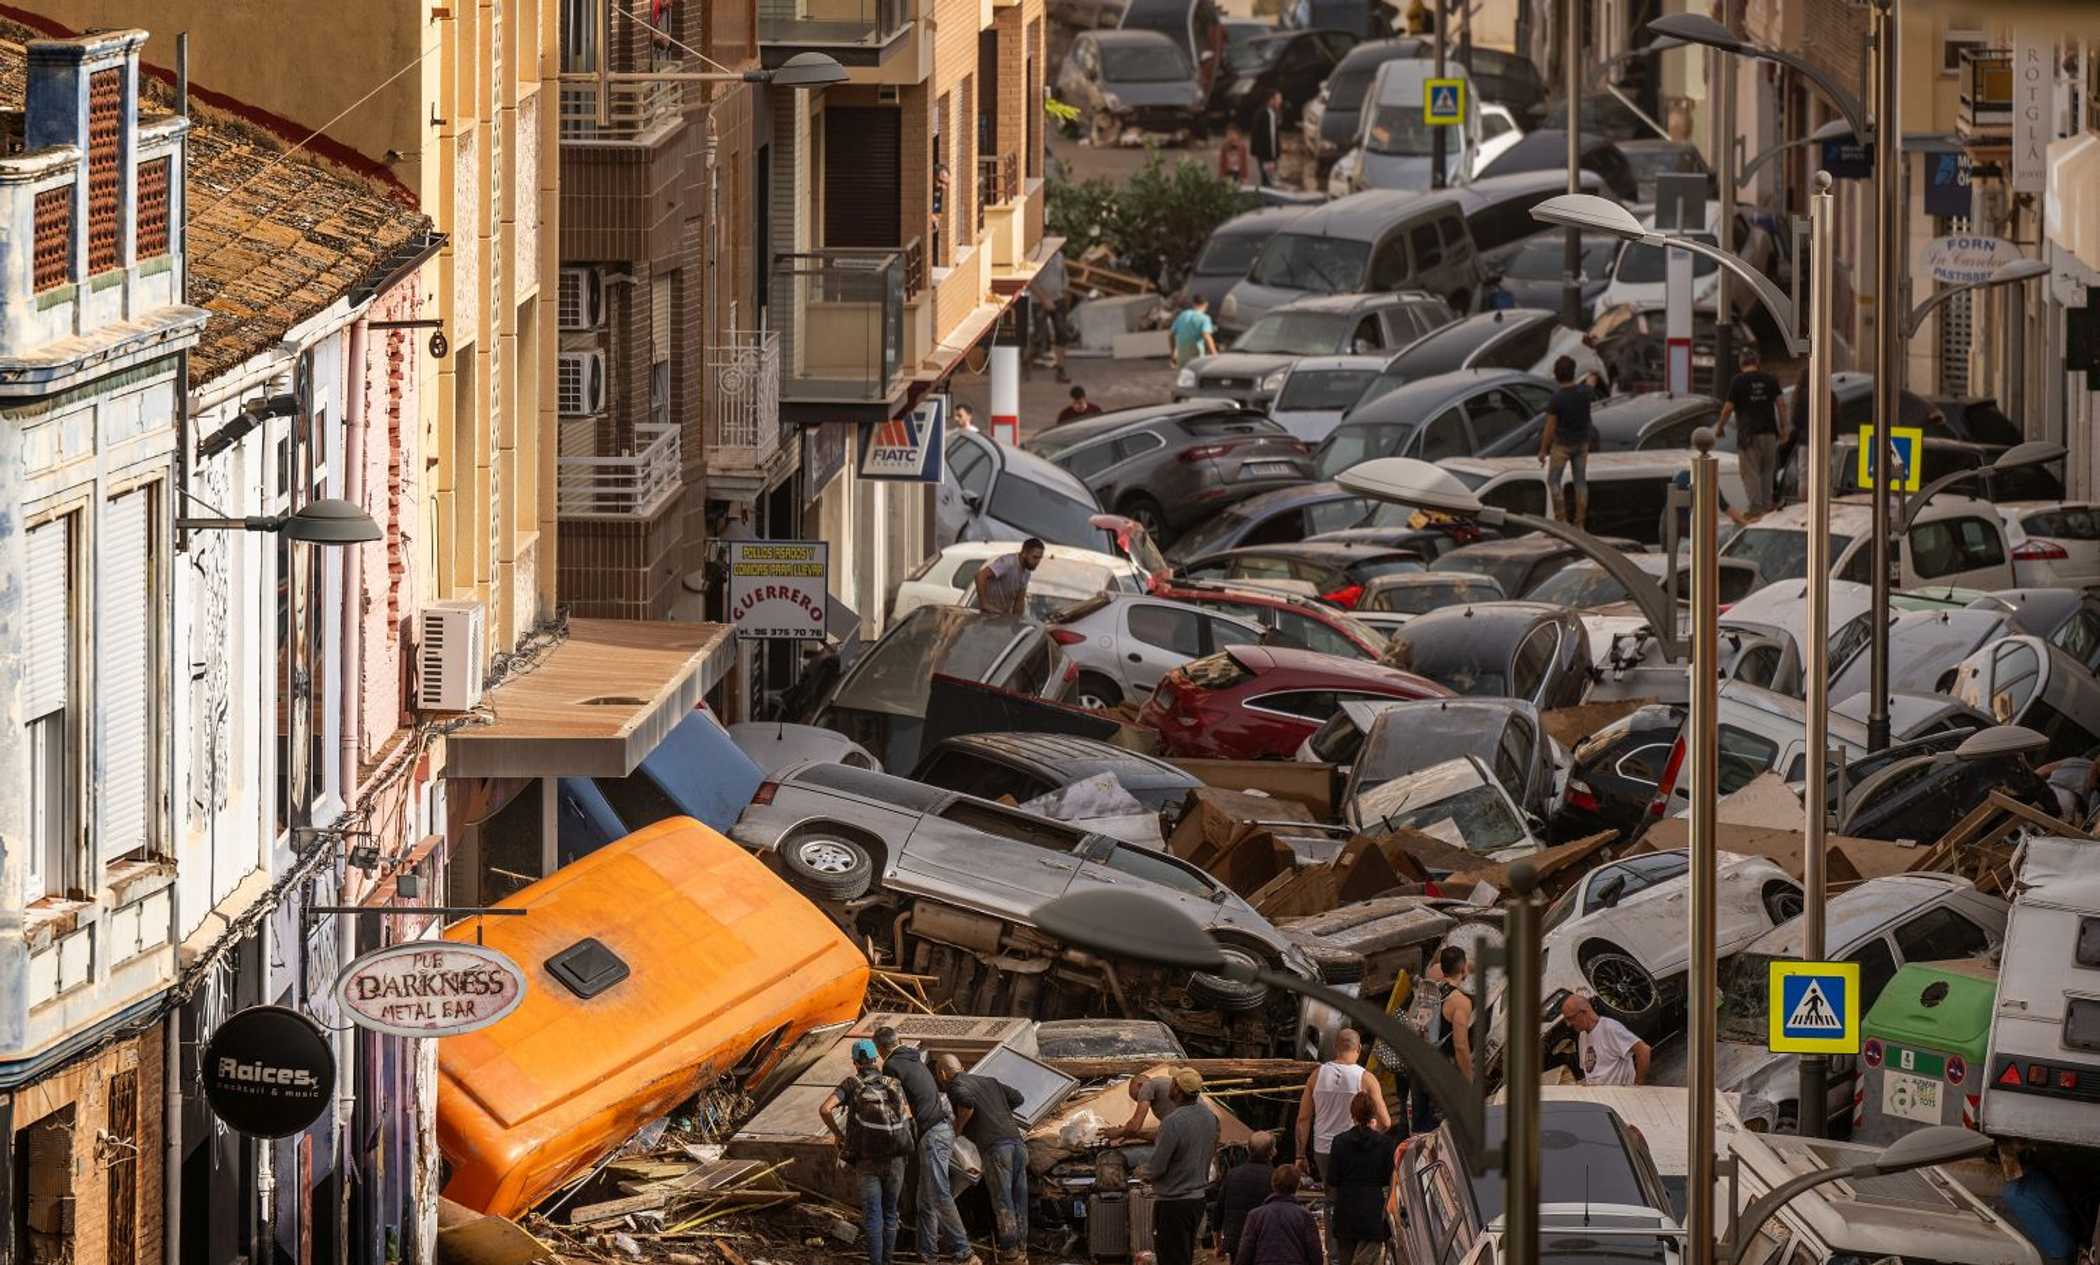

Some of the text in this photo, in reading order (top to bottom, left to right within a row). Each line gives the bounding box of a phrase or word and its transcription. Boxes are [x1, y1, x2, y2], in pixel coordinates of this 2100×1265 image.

[1946, 238, 1996, 252] FORN
[873, 448, 918, 462] FIATC
[733, 585, 823, 621] GUERRERO
[412, 952, 443, 969] PUB
[356, 969, 504, 1000] DARKNESS
[382, 1001, 477, 1021] METAL BAR
[285, 1089, 320, 1099] music
